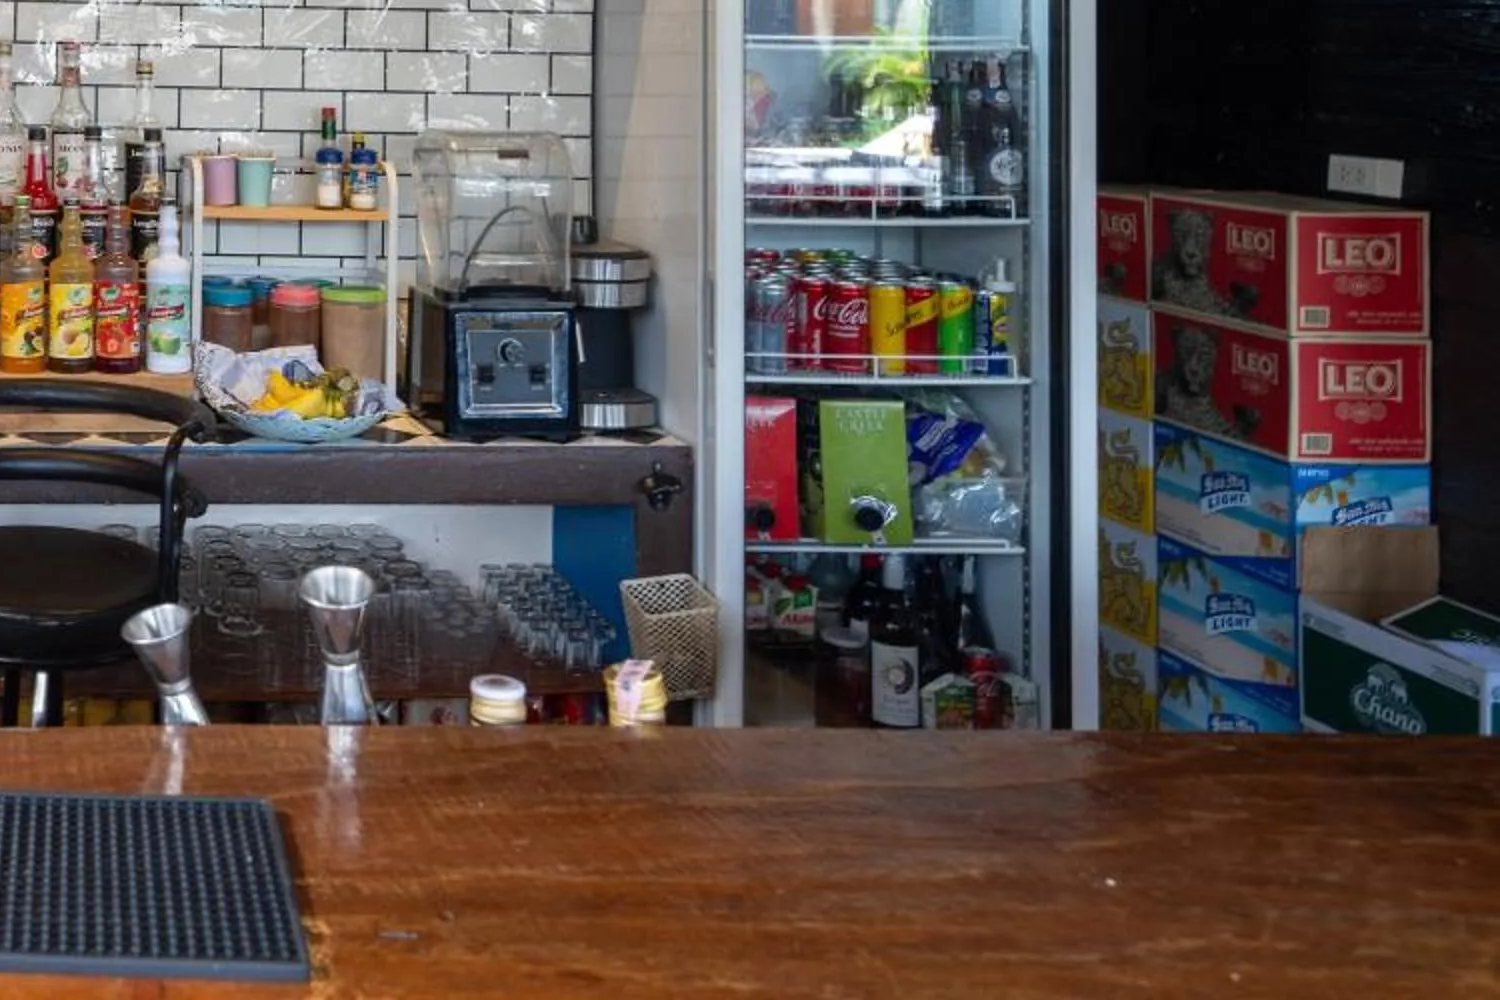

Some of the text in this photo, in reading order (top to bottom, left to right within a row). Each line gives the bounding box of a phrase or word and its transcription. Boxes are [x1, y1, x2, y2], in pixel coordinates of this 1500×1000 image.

[1104, 214, 1133, 234] LEO
[1231, 227, 1270, 251] LEO
[1325, 238, 1396, 268] LEO
[1237, 351, 1274, 376] LEO
[1325, 364, 1396, 394] LEO
[1208, 493, 1247, 509] LIGHT
[1213, 617, 1251, 631] LIGHT
